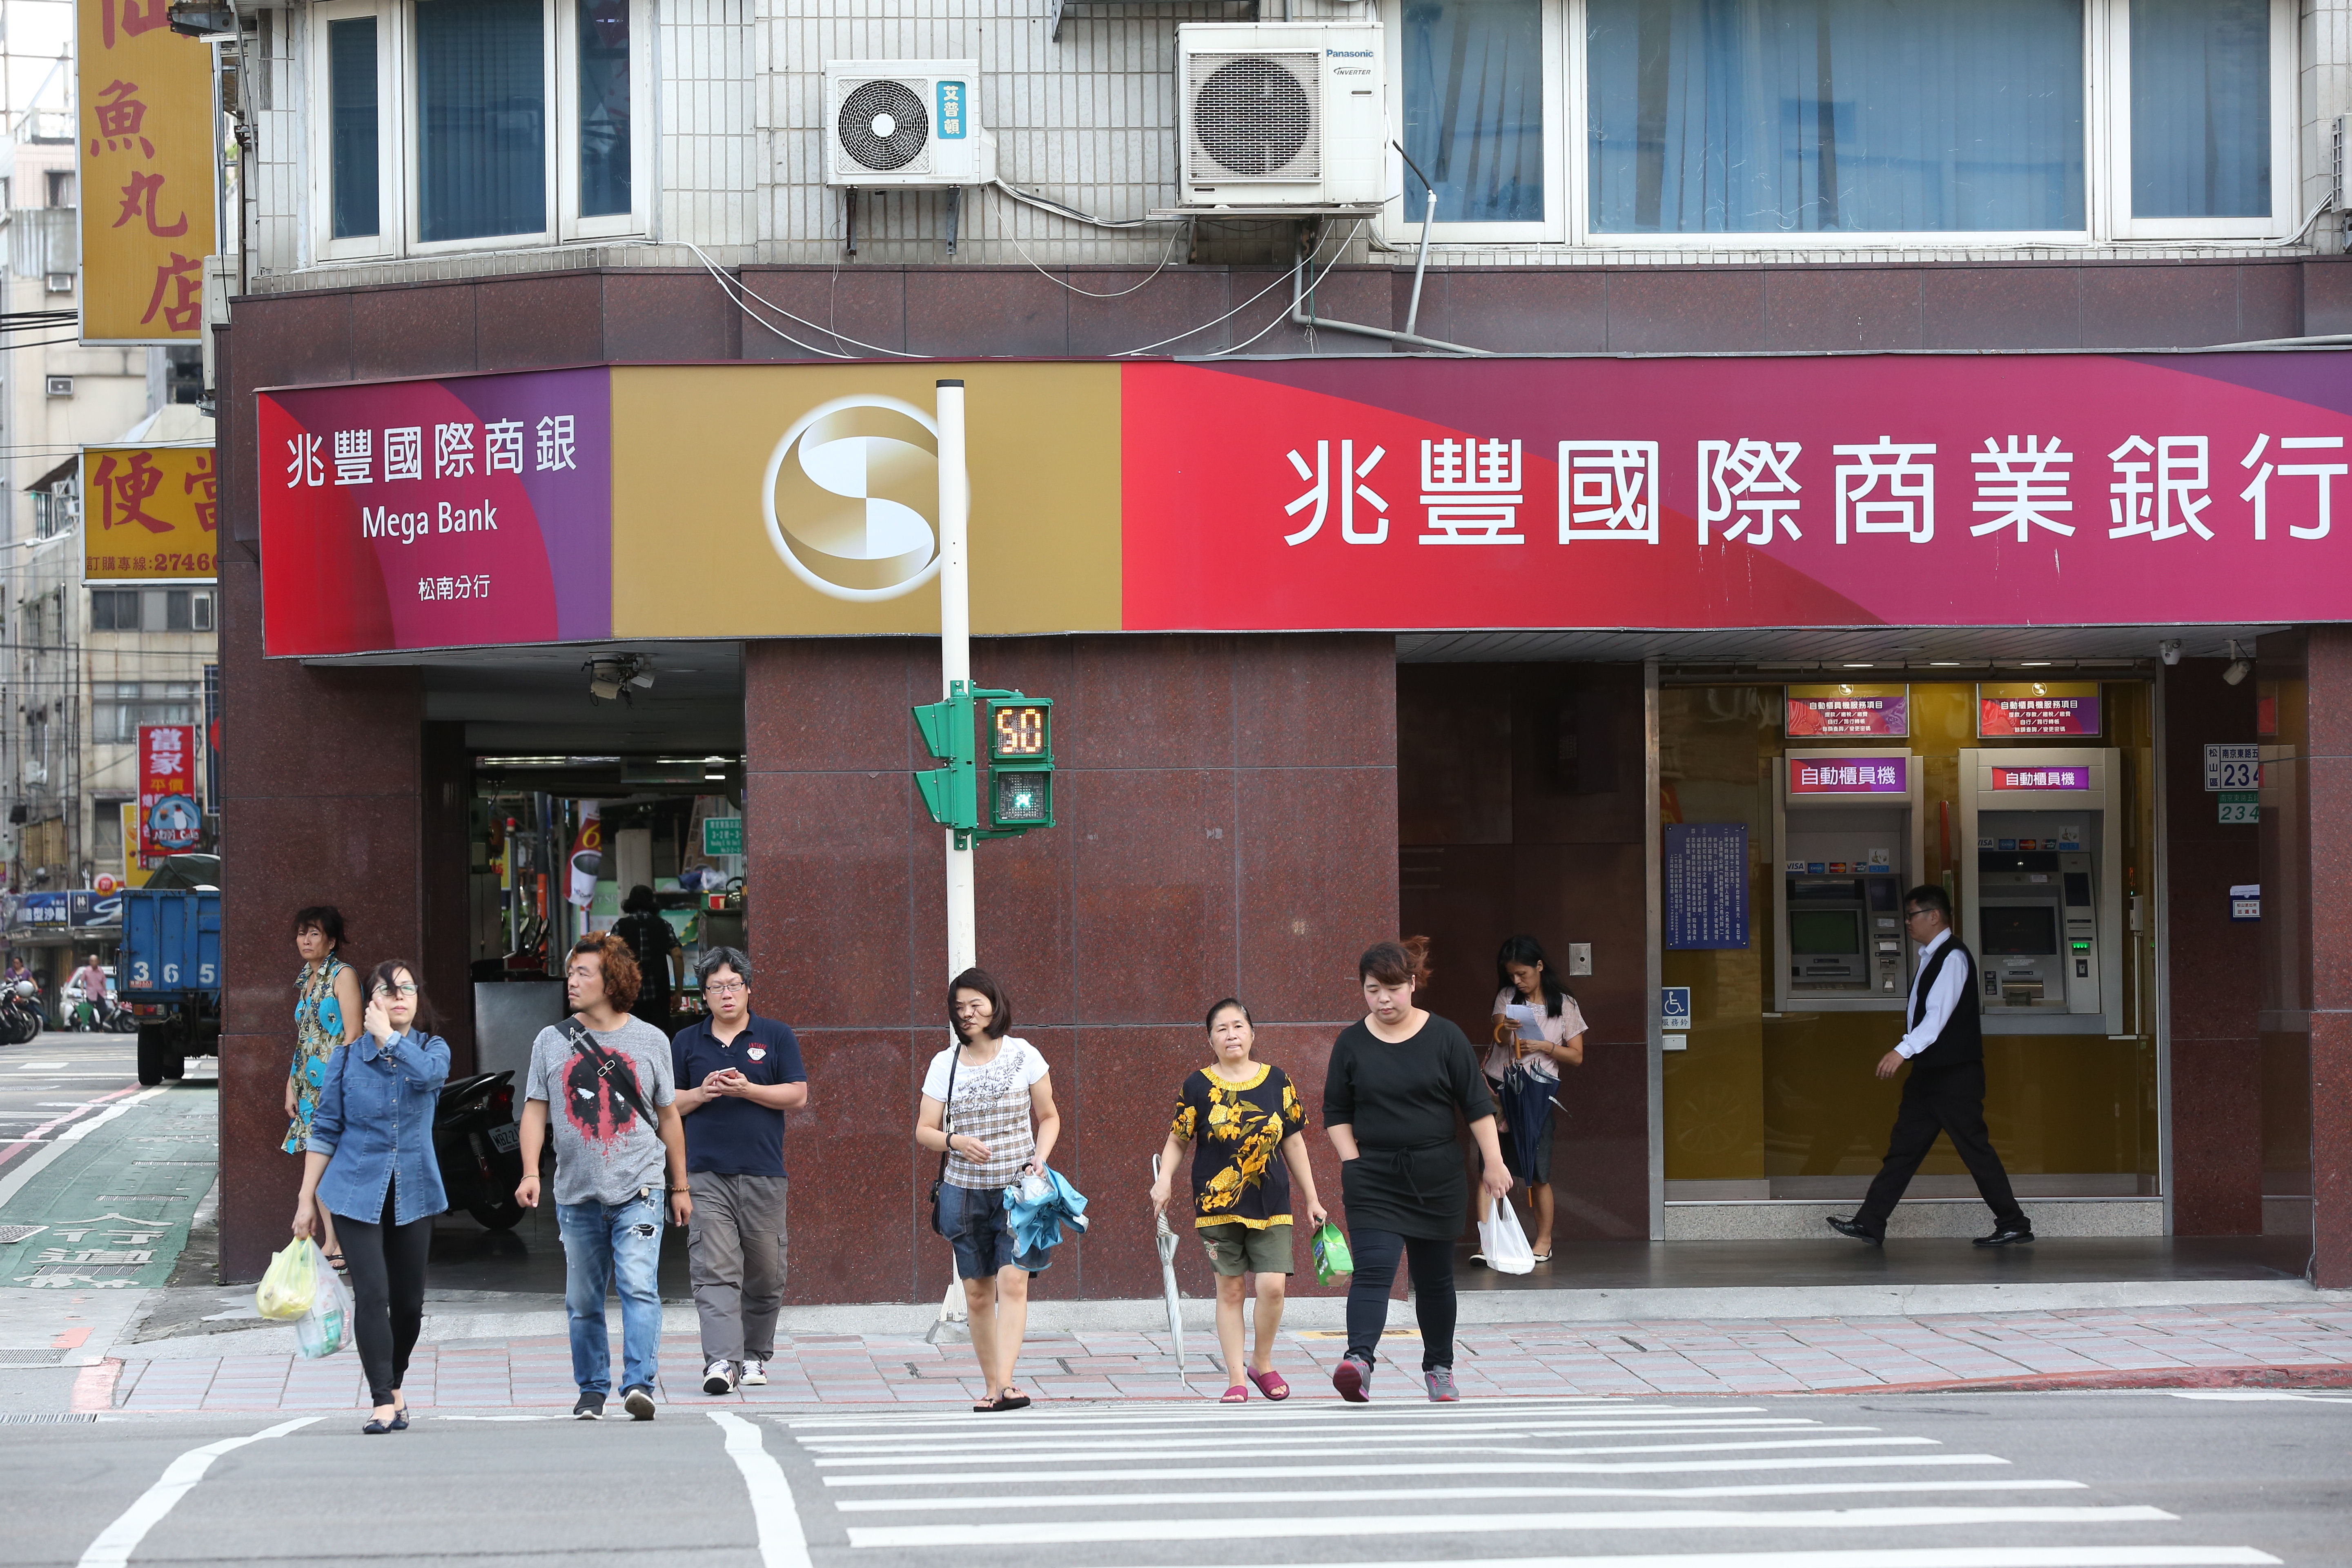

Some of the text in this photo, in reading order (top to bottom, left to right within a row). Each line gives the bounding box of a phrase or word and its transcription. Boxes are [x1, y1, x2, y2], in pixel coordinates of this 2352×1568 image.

[1326, 49, 1374, 58] Panasonic
[943, 85, 960, 135] 艾普頓
[287, 414, 577, 488] 兆豐國際商銀
[1283, 432, 2348, 547] 兆豐國際商業銀行
[363, 499, 498, 544] Mega Bank
[418, 574, 490, 601] 松南分行
[1810, 701, 1883, 710] 自動櫃員機服務項目
[2001, 700, 2078, 709] 自動櫃員機服務項目
[997, 708, 1040, 753] 50
[2223, 749, 2258, 758] 南京東路五
[1801, 766, 1896, 786] 自動櫃員機
[2209, 748, 2218, 786] 松山區
[2005, 771, 2075, 786] 自動櫃員機
[2221, 806, 2259, 820] 234
[492, 1128, 520, 1147] MBZ-21
